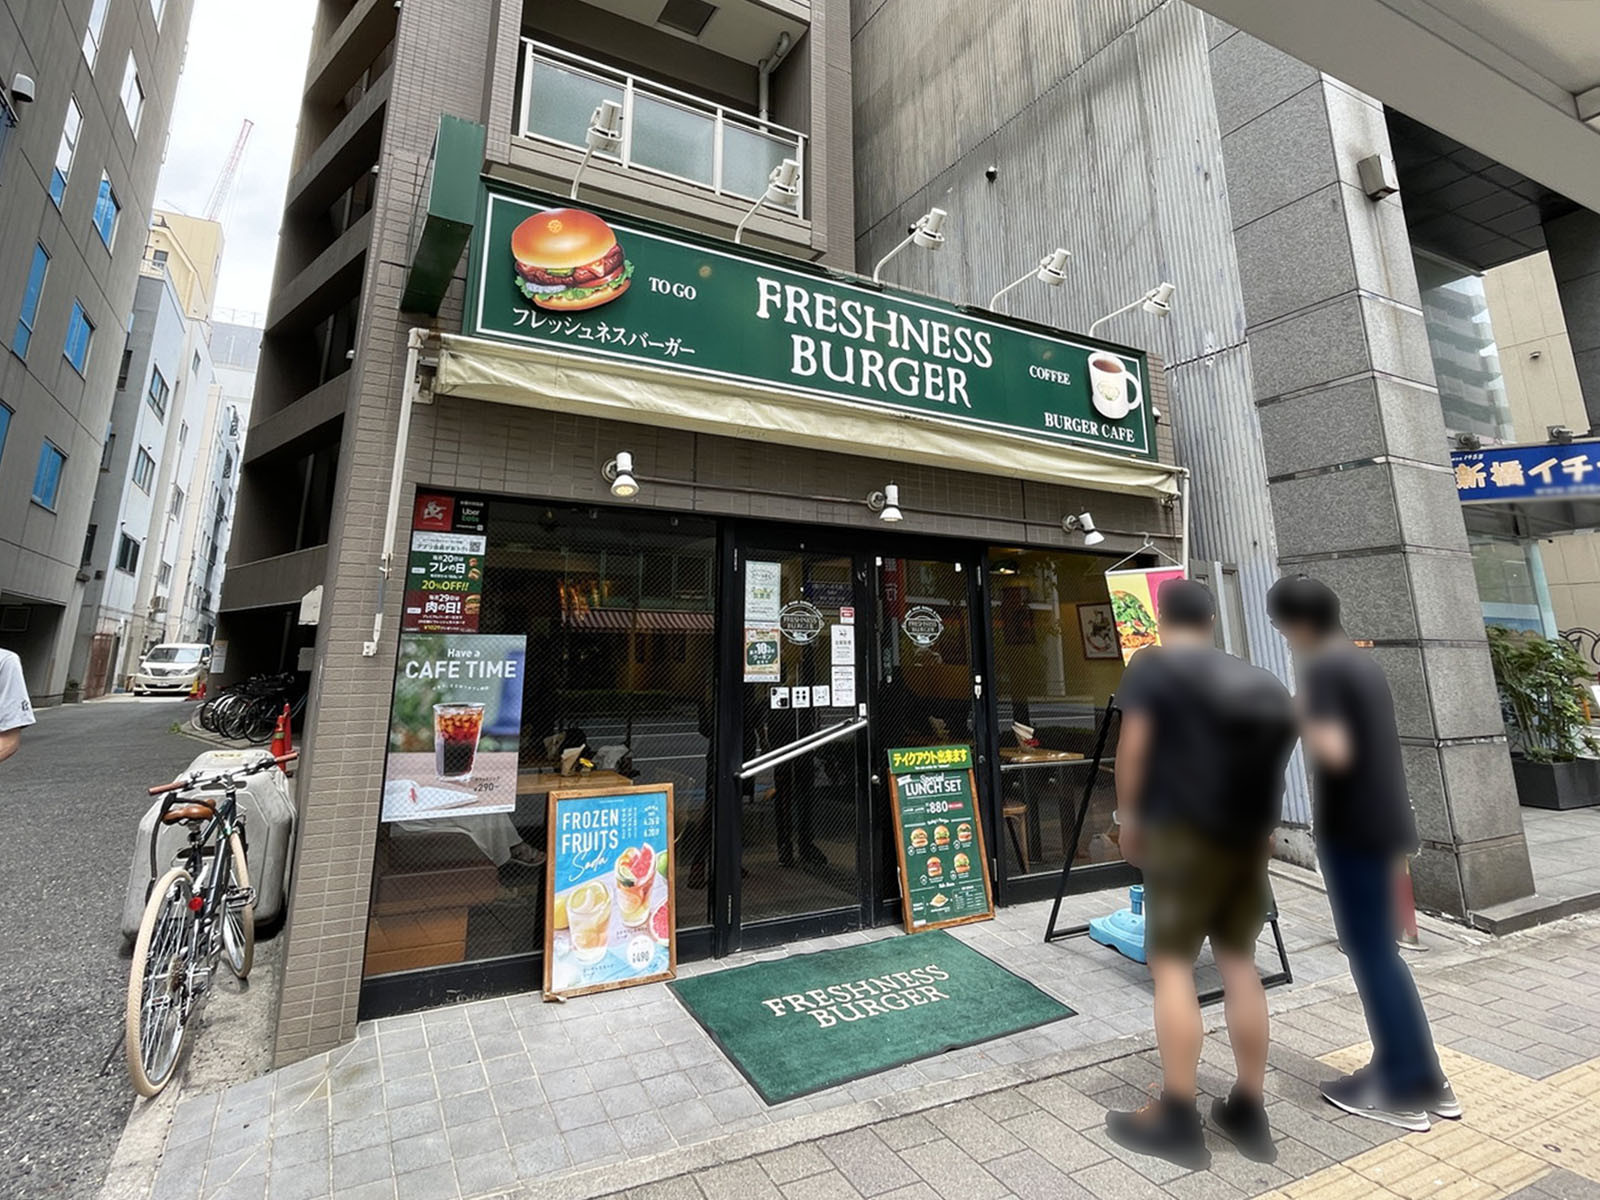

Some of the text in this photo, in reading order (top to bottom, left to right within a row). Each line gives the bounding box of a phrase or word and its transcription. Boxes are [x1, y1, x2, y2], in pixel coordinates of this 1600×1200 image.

[649, 277, 697, 301] TO GO
[512, 307, 696, 357] フレッシュネスバーガー
[756, 277, 993, 369] FRESHNESS
[790, 334, 972, 408] BURGER
[1029, 364, 1071, 386] COFFEE
[1044, 411, 1135, 444] BURGER CAFE
[1455, 454, 1600, 489] 新橋イチ
[462, 507, 480, 515] Uber
[429, 562, 466, 574] フレの日
[421, 580, 470, 592] 20%OFF!!
[425, 601, 461, 614] 肉の日!
[447, 648, 480, 658] Have a
[405, 661, 517, 679] CAFE TIME
[893, 748, 967, 767] テイクアウト出来ます
[905, 779, 962, 796] LUNCH SET
[562, 808, 619, 831] FROZEN
[562, 829, 619, 855] FRUITS
[762, 964, 949, 1017] FRESHNESS
[807, 986, 949, 1028] BURGER
